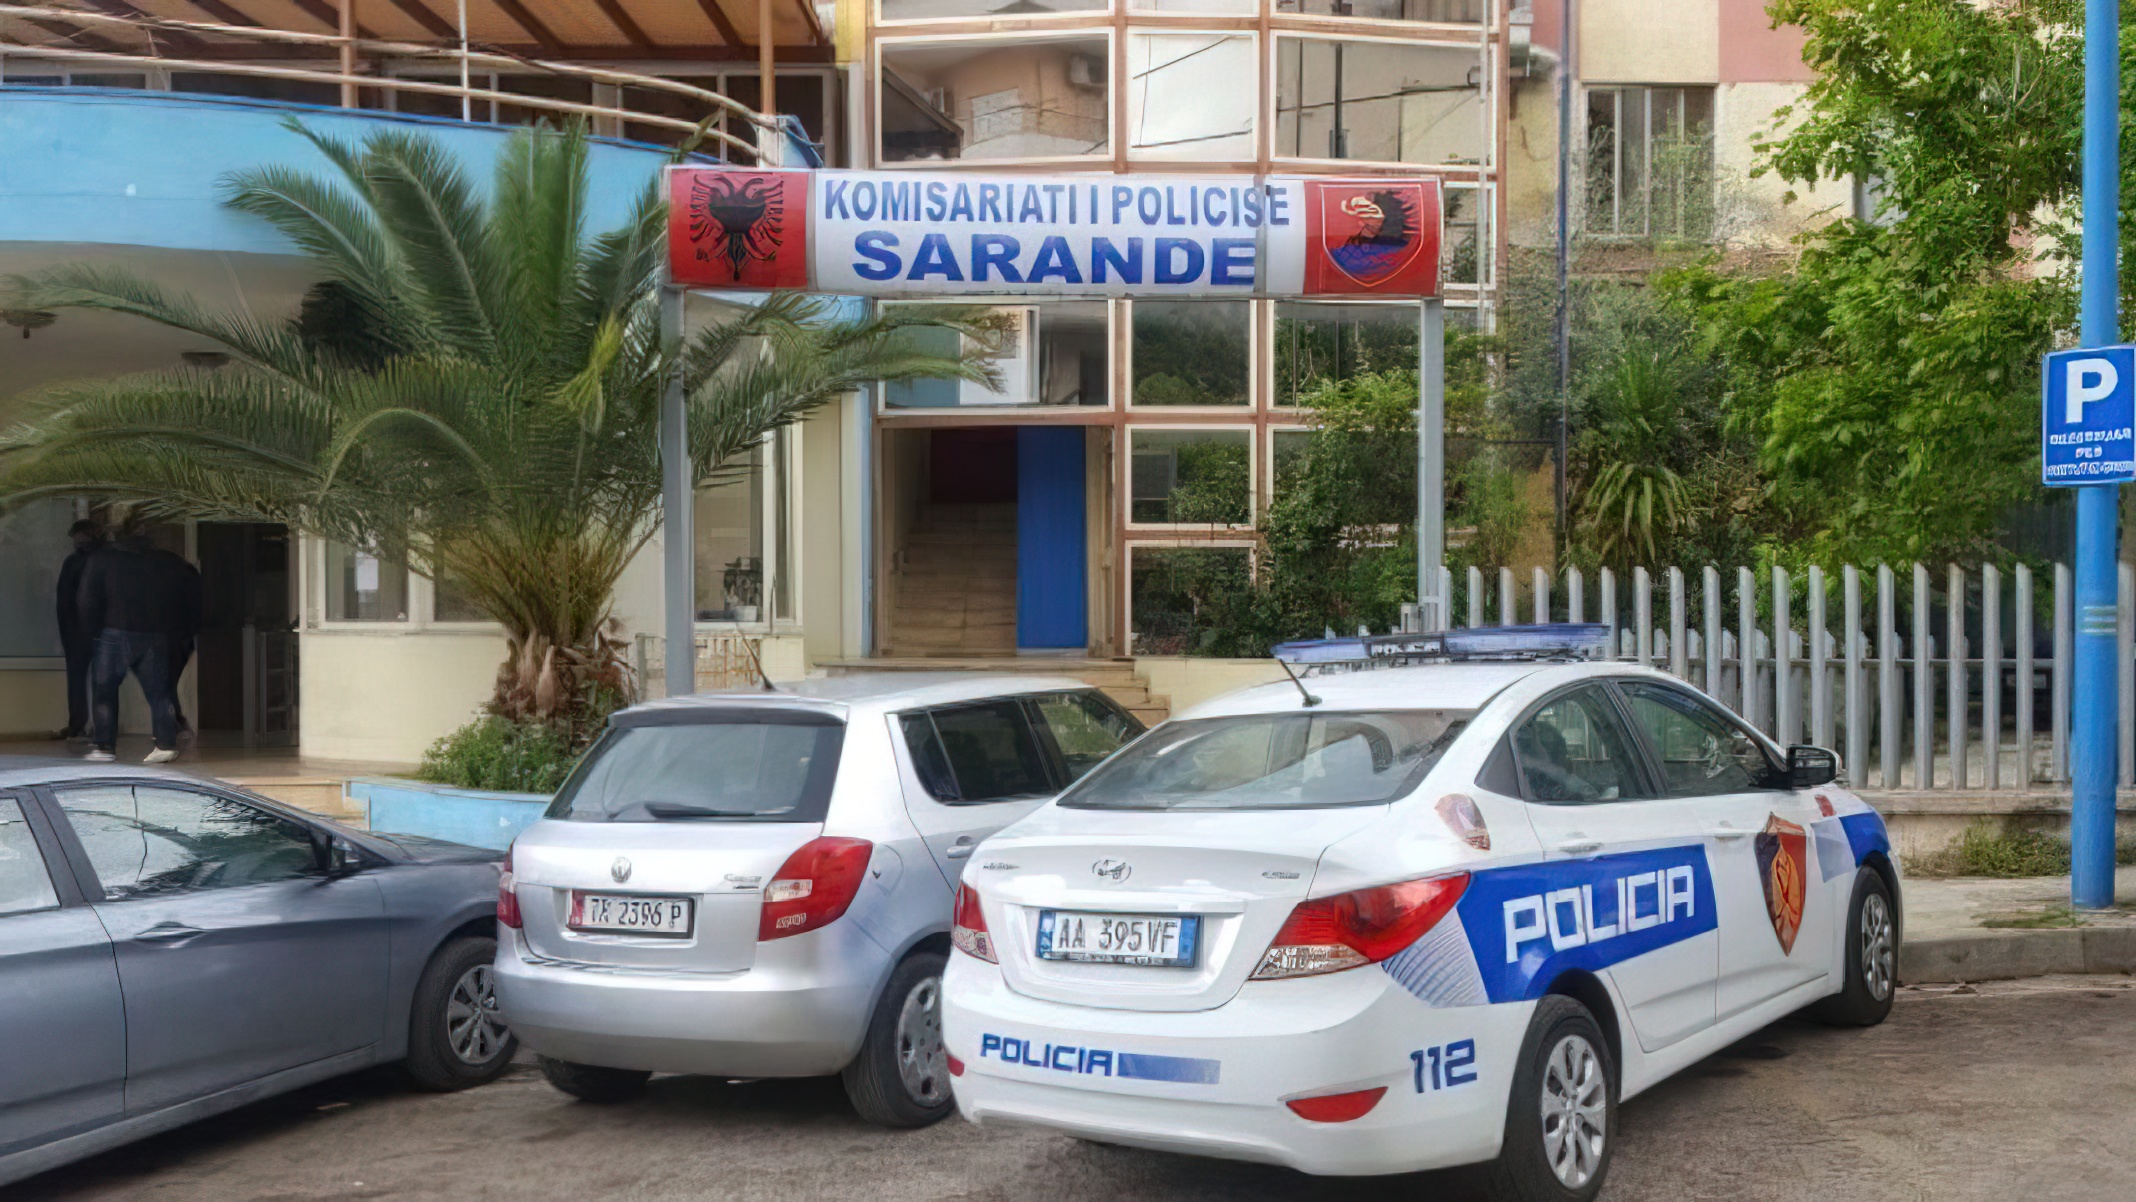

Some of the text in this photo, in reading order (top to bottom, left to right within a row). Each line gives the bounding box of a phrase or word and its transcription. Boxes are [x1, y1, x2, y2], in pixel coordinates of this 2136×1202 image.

[824, 179, 1078, 225] KOMISARIATI
[1111, 184, 1290, 228] POLICISE
[852, 229, 1257, 286] SARANDE
[2066, 358, 2118, 423] P
[1058, 917, 1086, 949] AA
[1503, 864, 1695, 964] POLICIA
[980, 1032, 1113, 1077] POLICIA
[1410, 1038, 1478, 1094] 112
